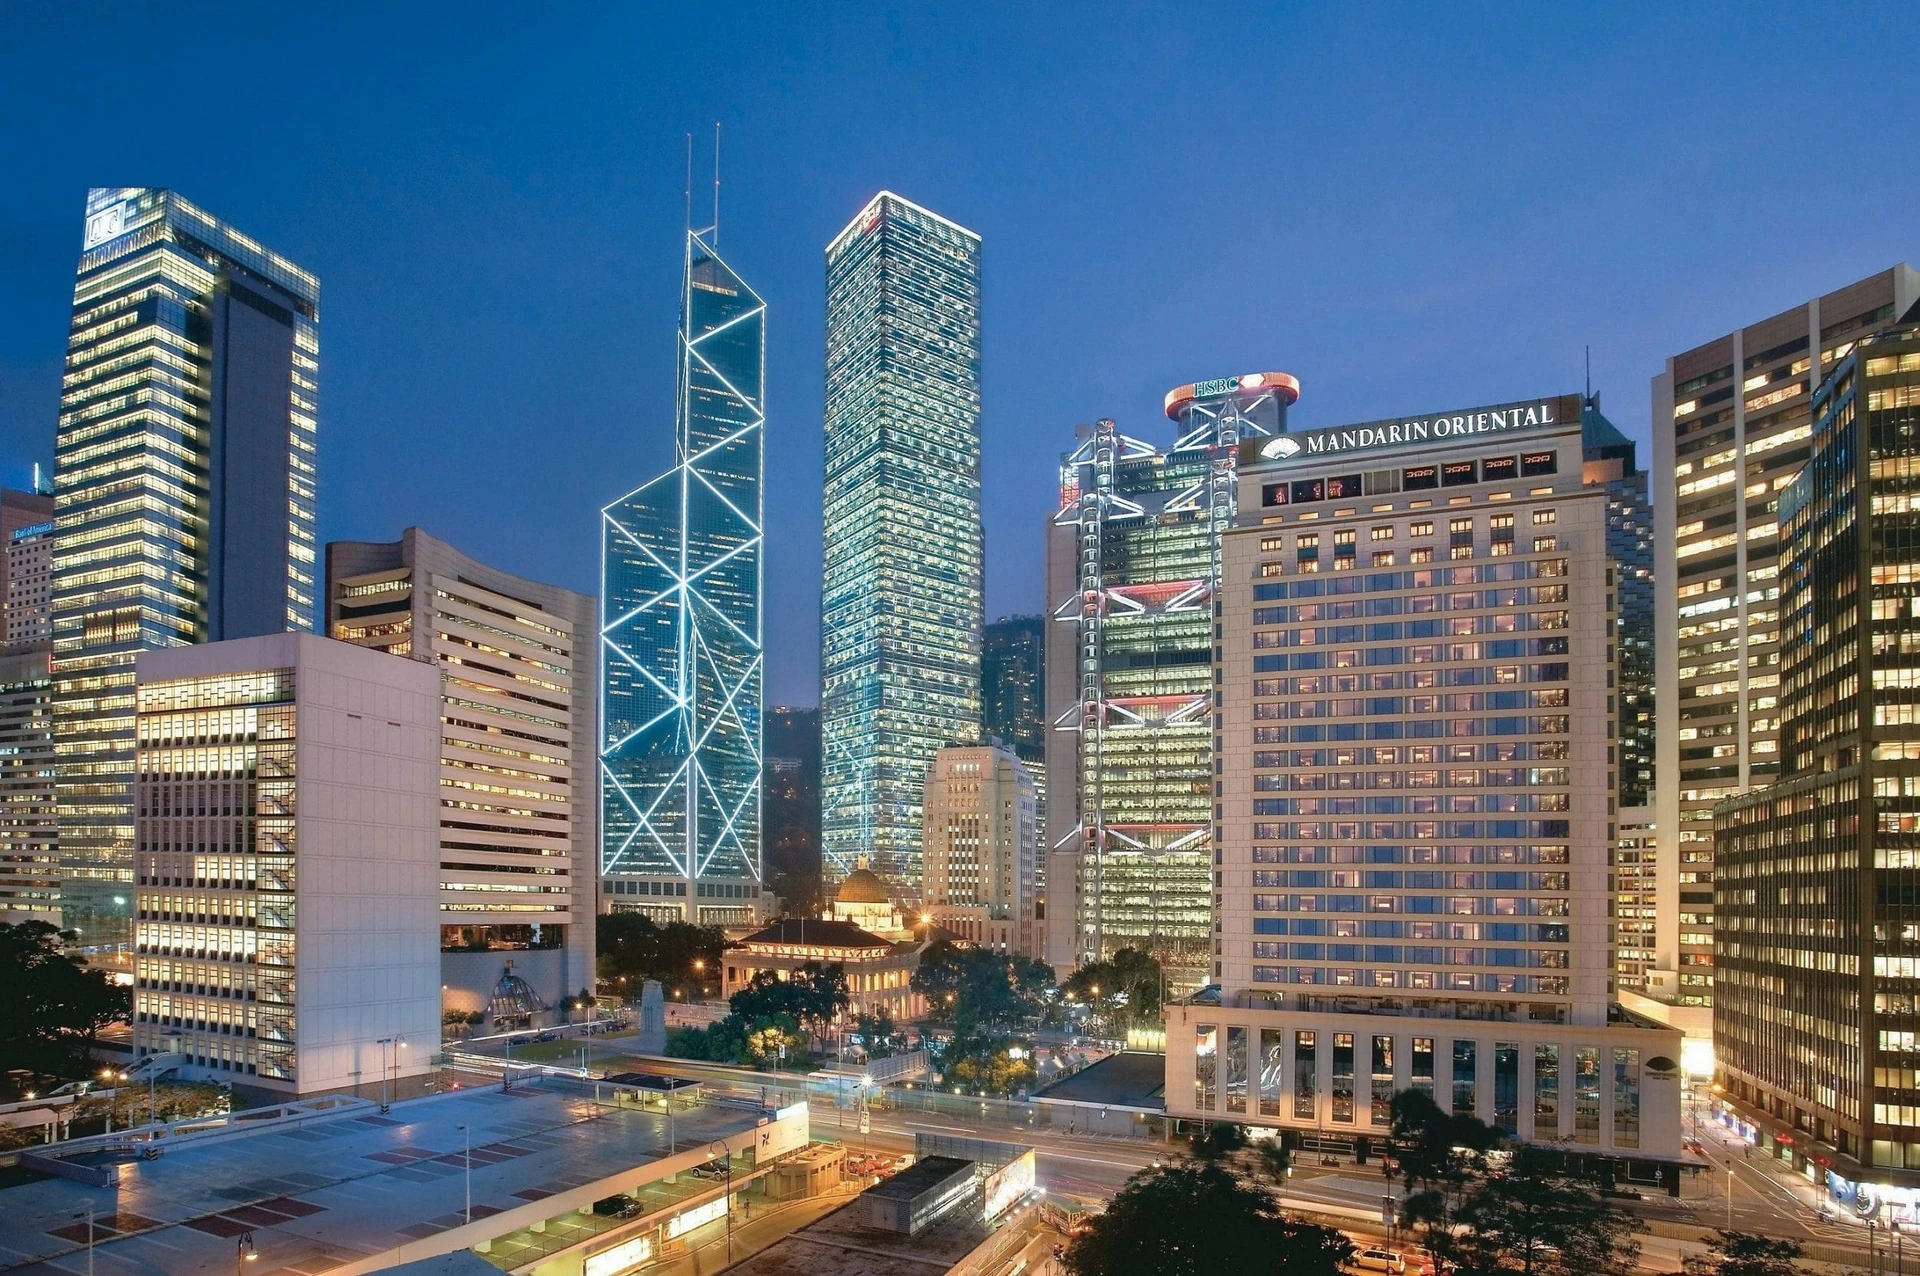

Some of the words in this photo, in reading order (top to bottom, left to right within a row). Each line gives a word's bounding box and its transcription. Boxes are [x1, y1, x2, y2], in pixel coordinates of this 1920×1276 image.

[1193, 377, 1239, 397] HSBC
[1307, 421, 1428, 453] MANDARIN
[1433, 405, 1554, 436] ORIENTAL
